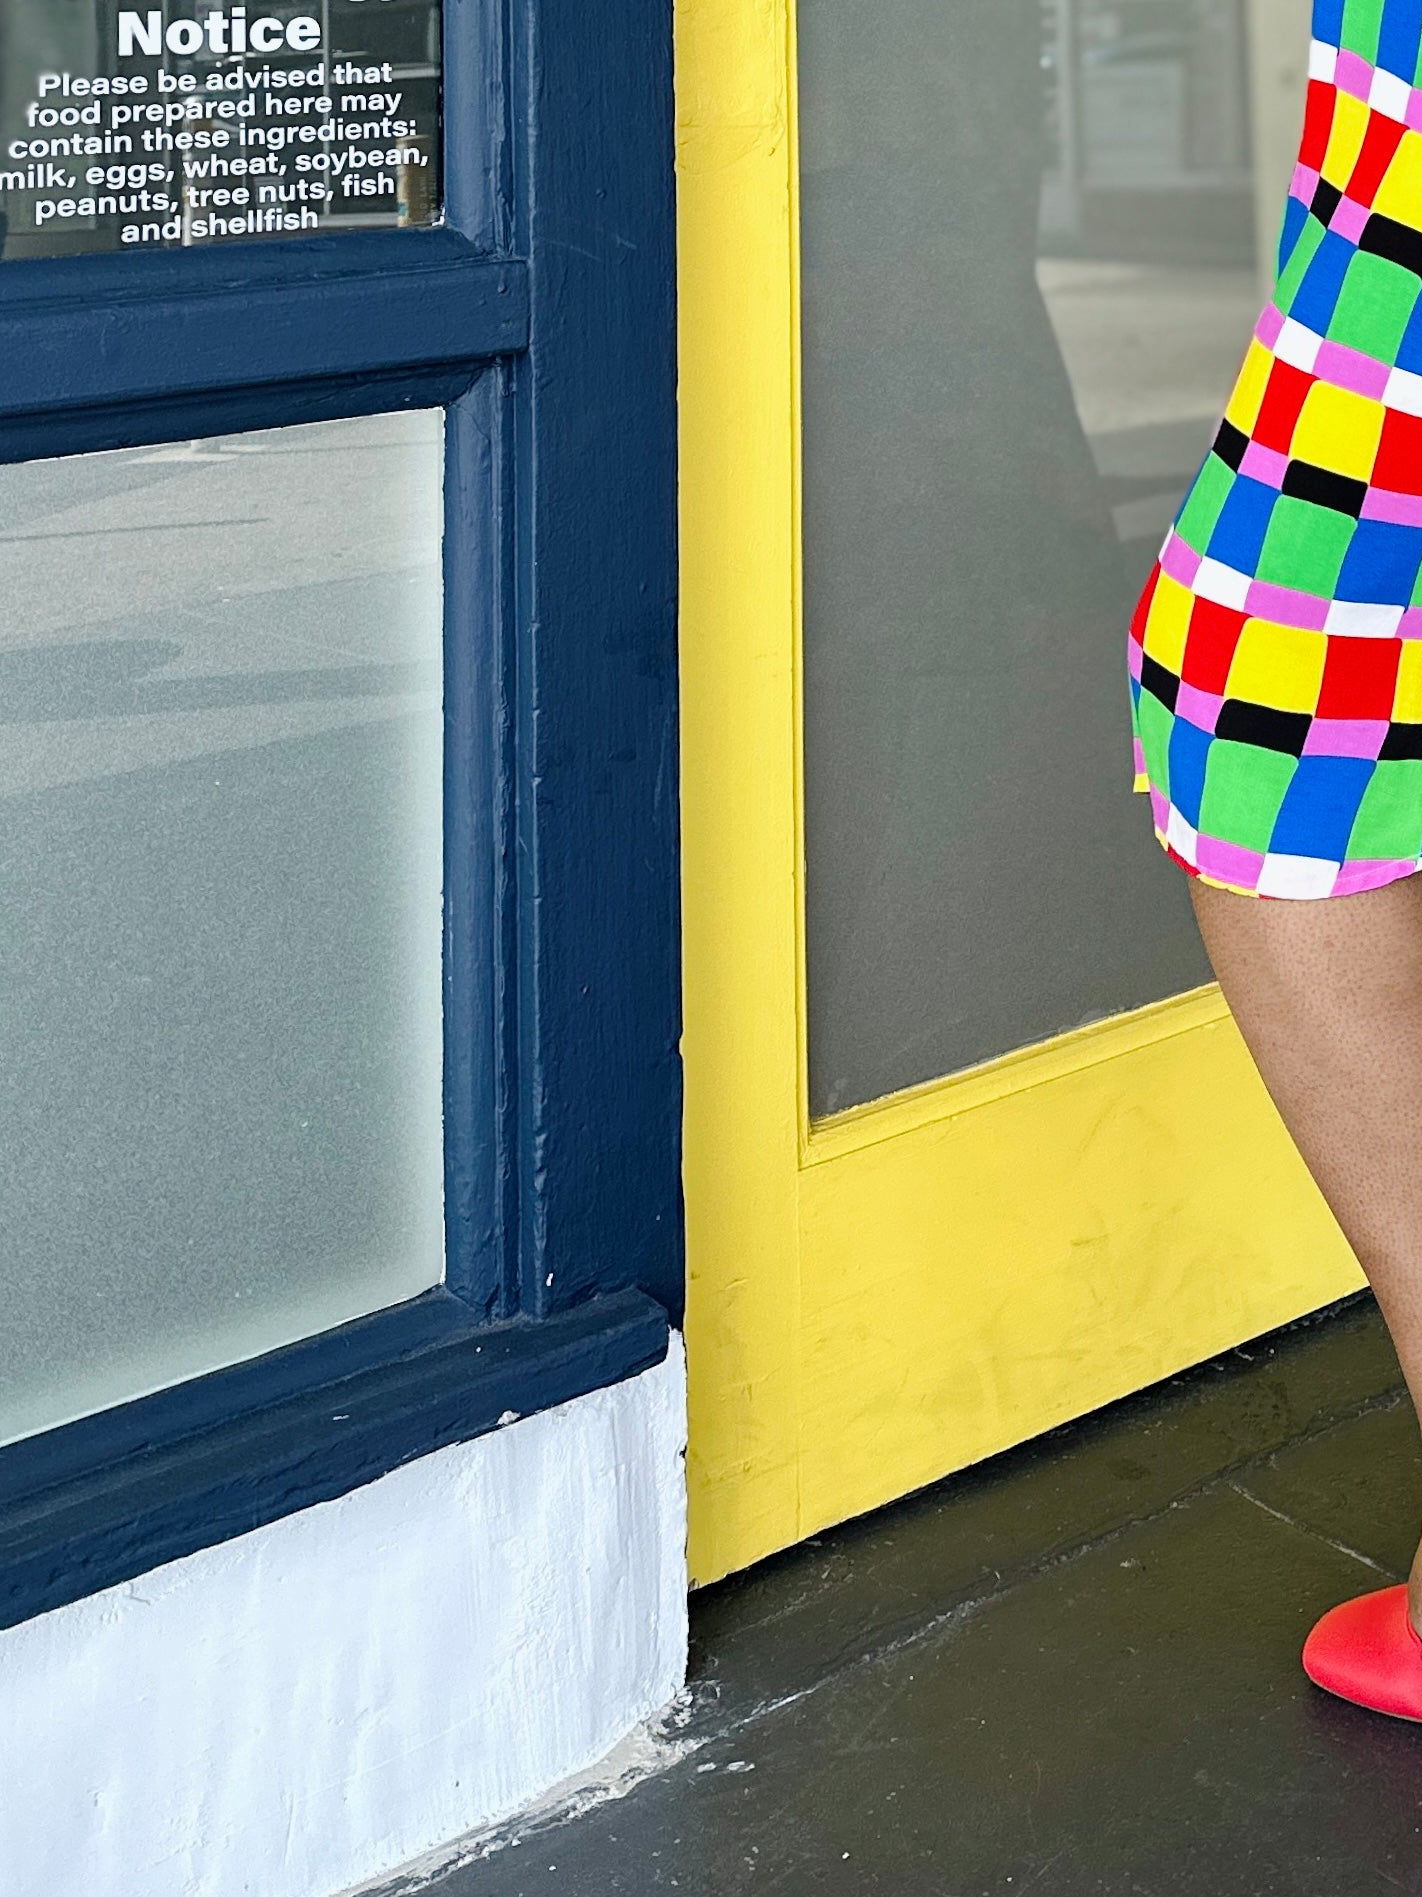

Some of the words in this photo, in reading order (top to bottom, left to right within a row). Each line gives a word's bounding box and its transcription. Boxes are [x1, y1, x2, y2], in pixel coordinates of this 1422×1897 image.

[118, 6, 321, 56] Notice
[39, 72, 148, 98] Please
[158, 68, 197, 93] be
[205, 62, 325, 91] advised
[333, 61, 393, 85] that
[26, 100, 101, 128] food
[111, 93, 256, 130] prepared
[265, 92, 333, 116] here
[341, 93, 402, 116] may
[8, 129, 132, 159] contain
[140, 127, 230, 152] these
[239, 117, 416, 151] ingredients:
[0, 162, 76, 191] milk,
[85, 163, 175, 190] eggs,
[182, 152, 287, 179] wheat,
[295, 145, 428, 176] soybean,
[35, 190, 178, 226] peanuts,
[187, 185, 250, 208] tree
[259, 179, 334, 203] nuts,
[341, 171, 395, 197] fish
[121, 214, 181, 243] and
[190, 205, 318, 238] shellfish
